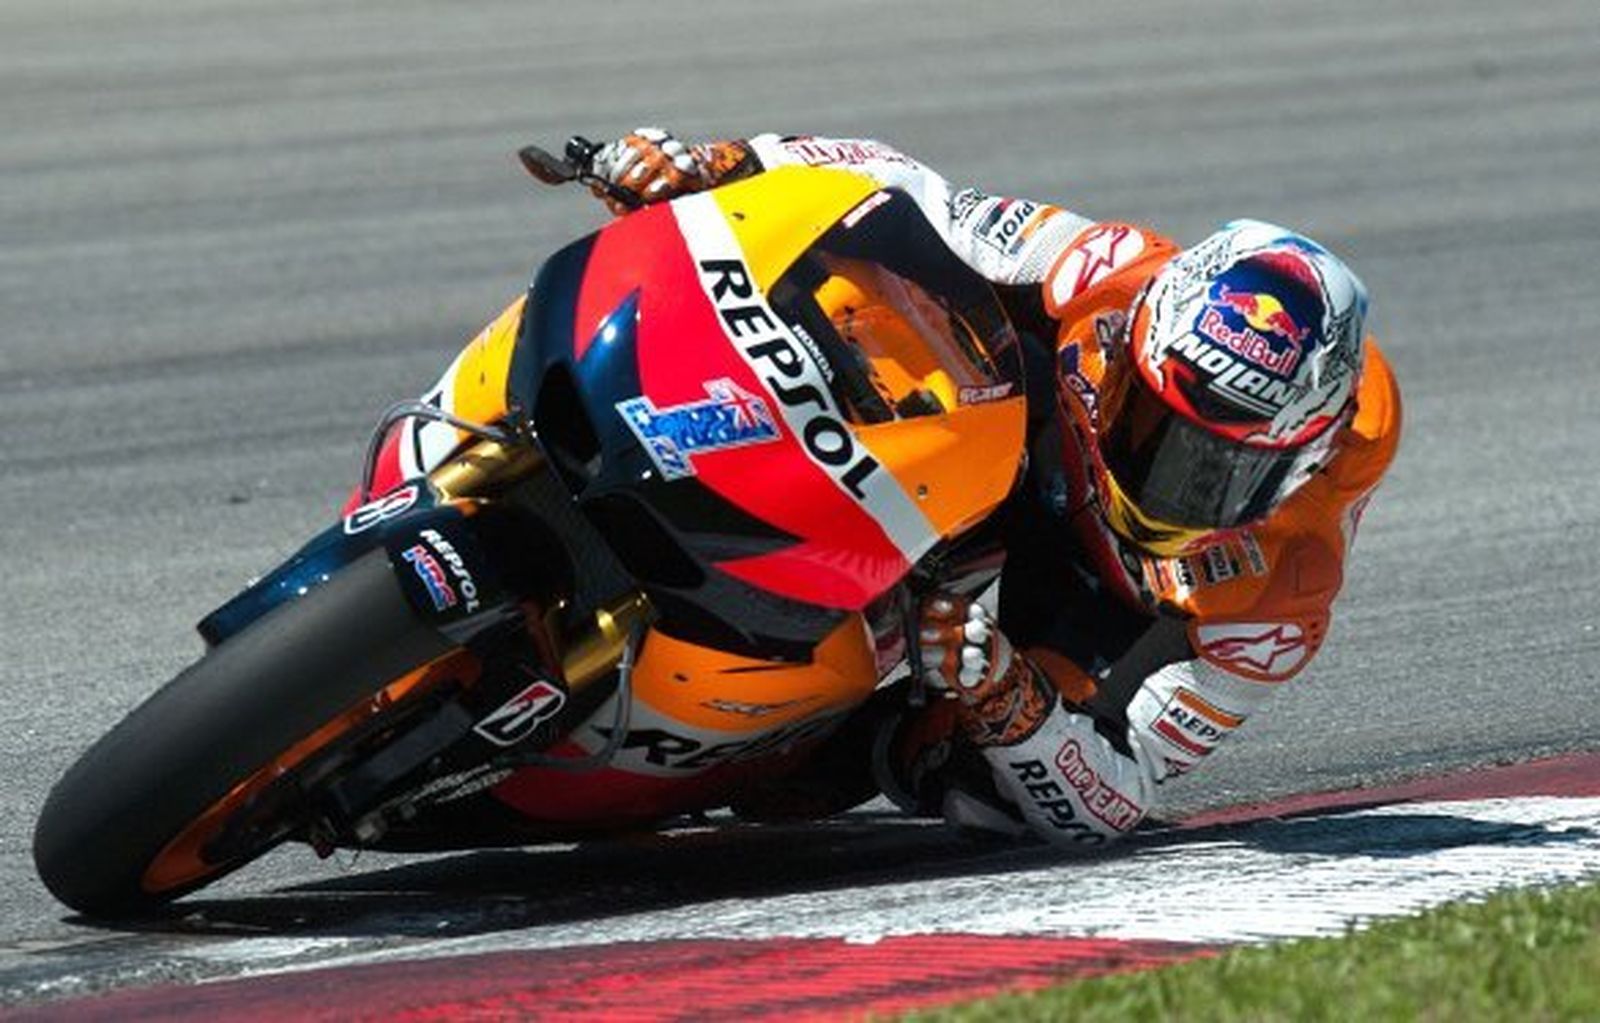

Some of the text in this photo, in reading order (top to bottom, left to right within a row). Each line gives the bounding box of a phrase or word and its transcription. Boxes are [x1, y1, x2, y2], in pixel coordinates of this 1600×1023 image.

[699, 258, 879, 500] REPSOL
[792, 323, 835, 383] HONDA
[420, 529, 480, 614] REPSOL
